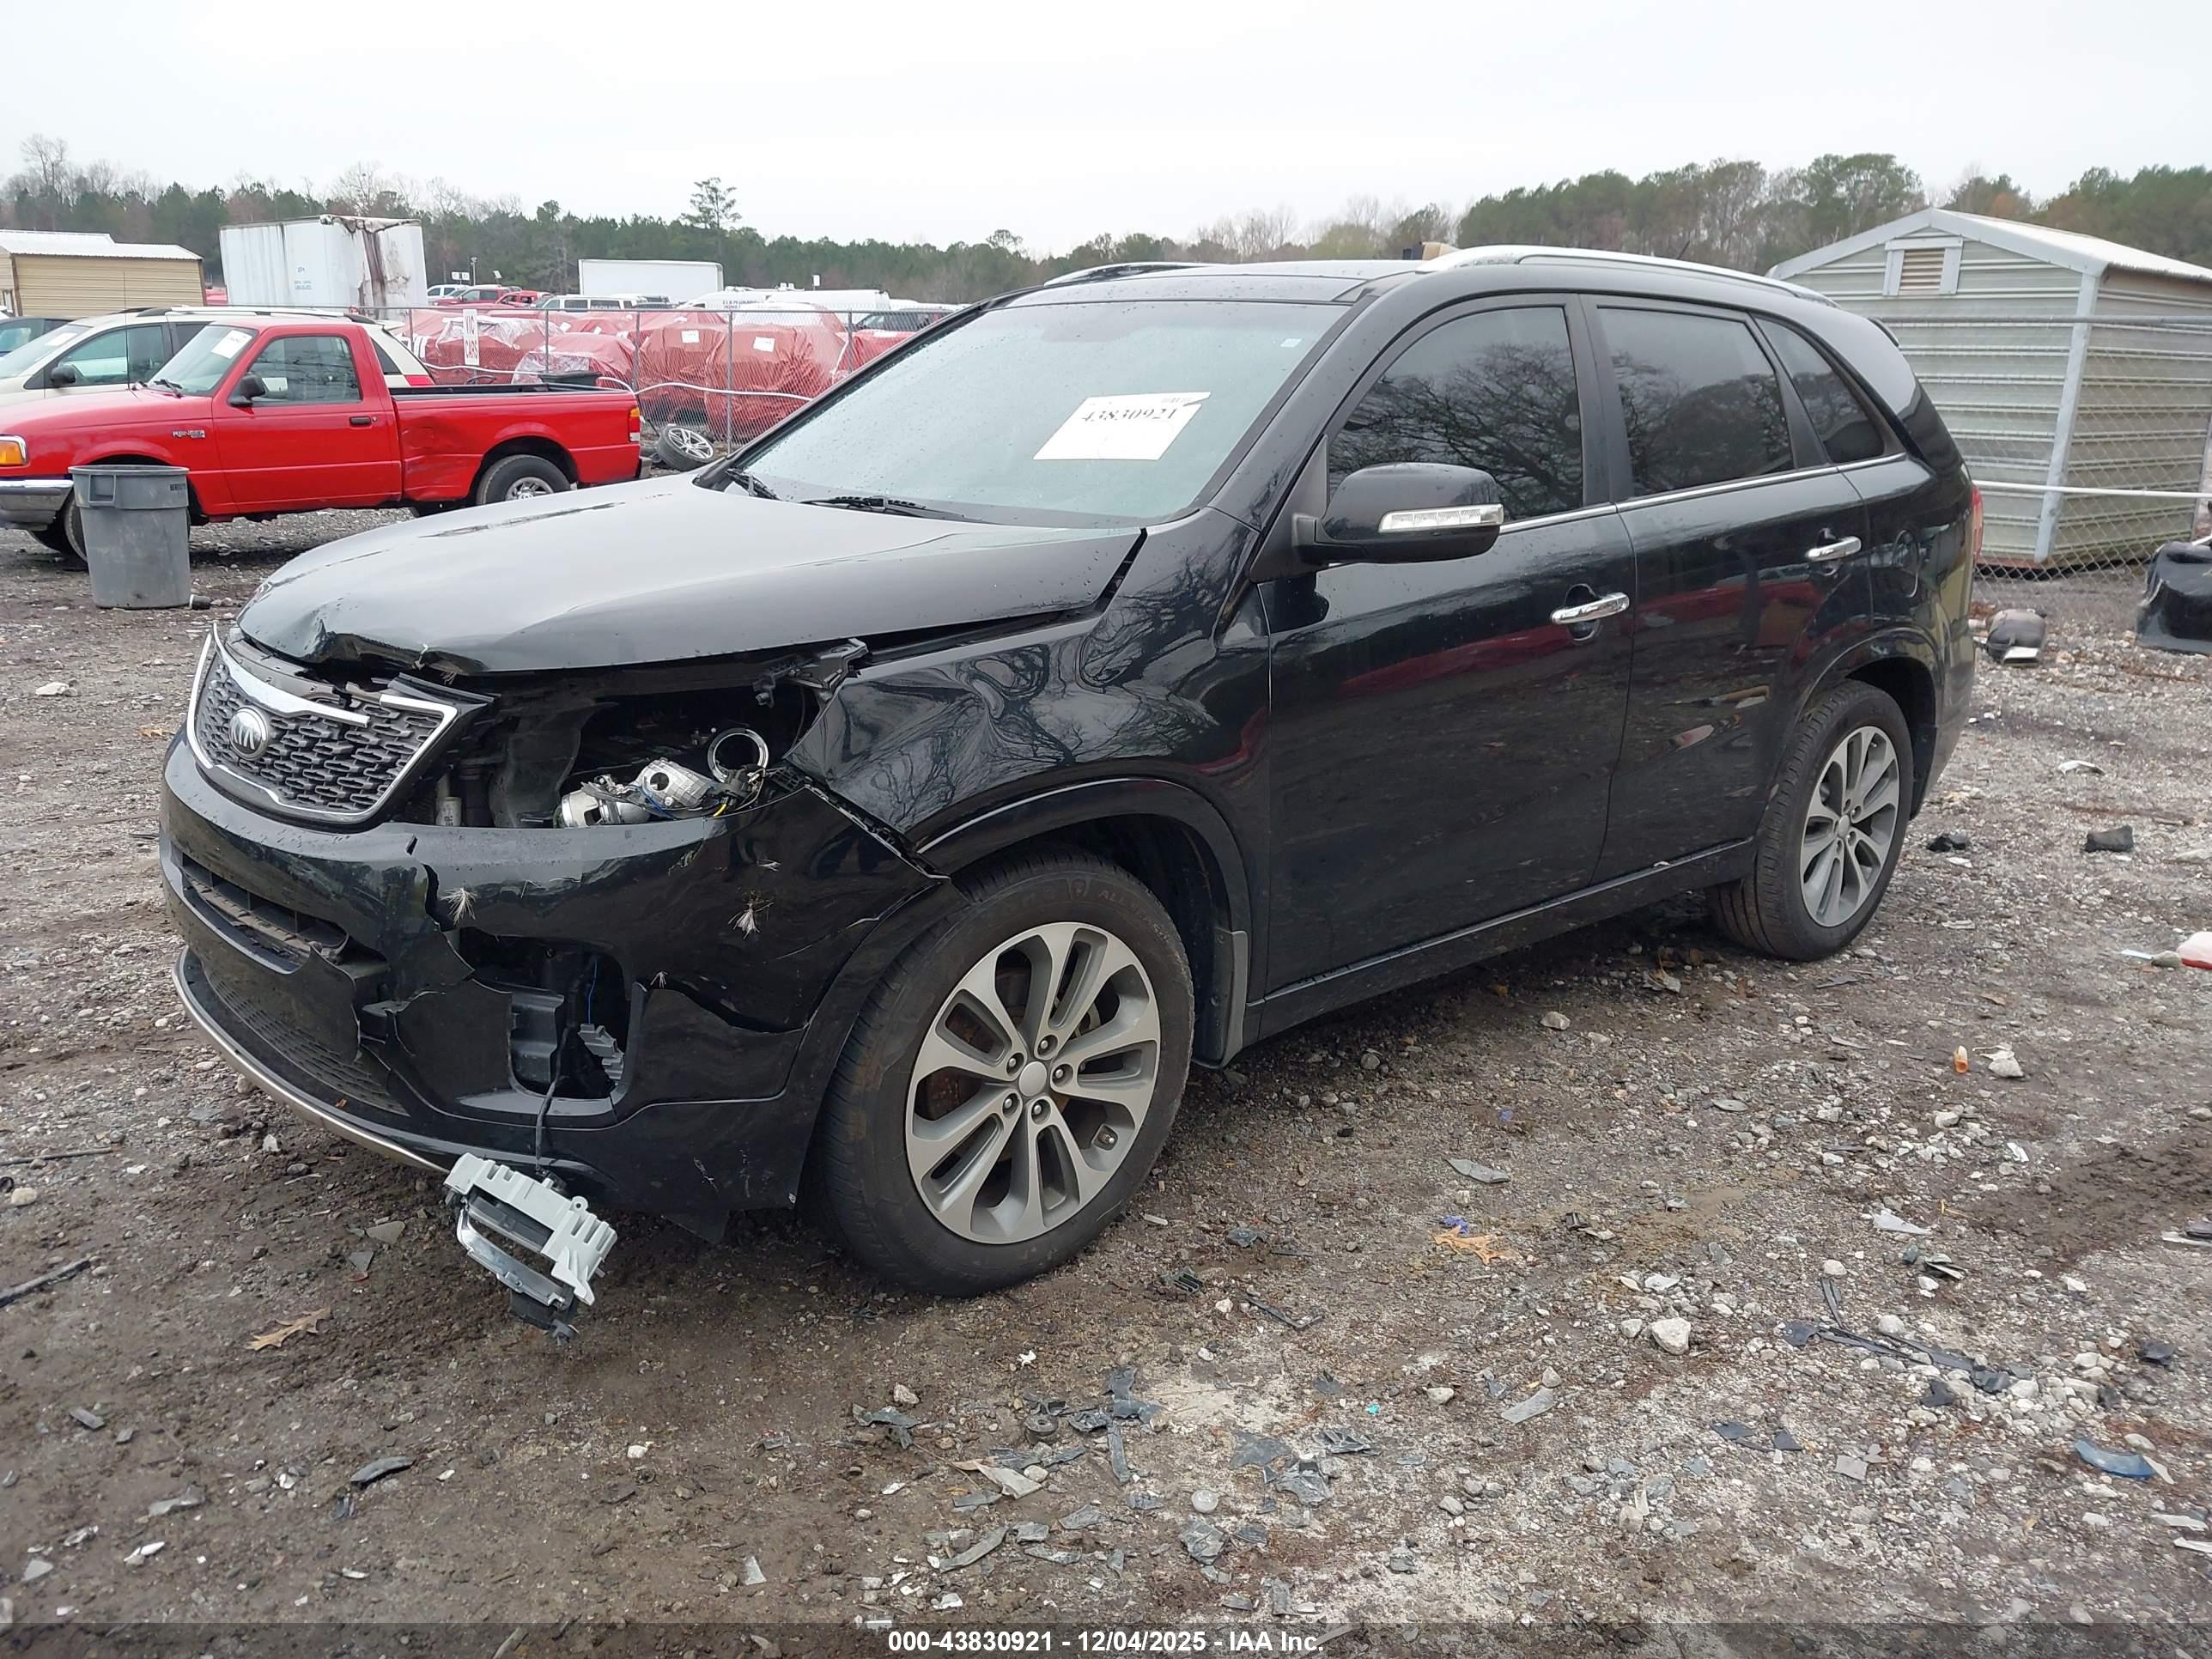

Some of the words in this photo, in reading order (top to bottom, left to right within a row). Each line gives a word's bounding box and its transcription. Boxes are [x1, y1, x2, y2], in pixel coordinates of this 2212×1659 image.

[465, 340, 477, 359] CARS
[1082, 407, 1177, 422] 43830921
[230, 720, 257, 750] KIA
